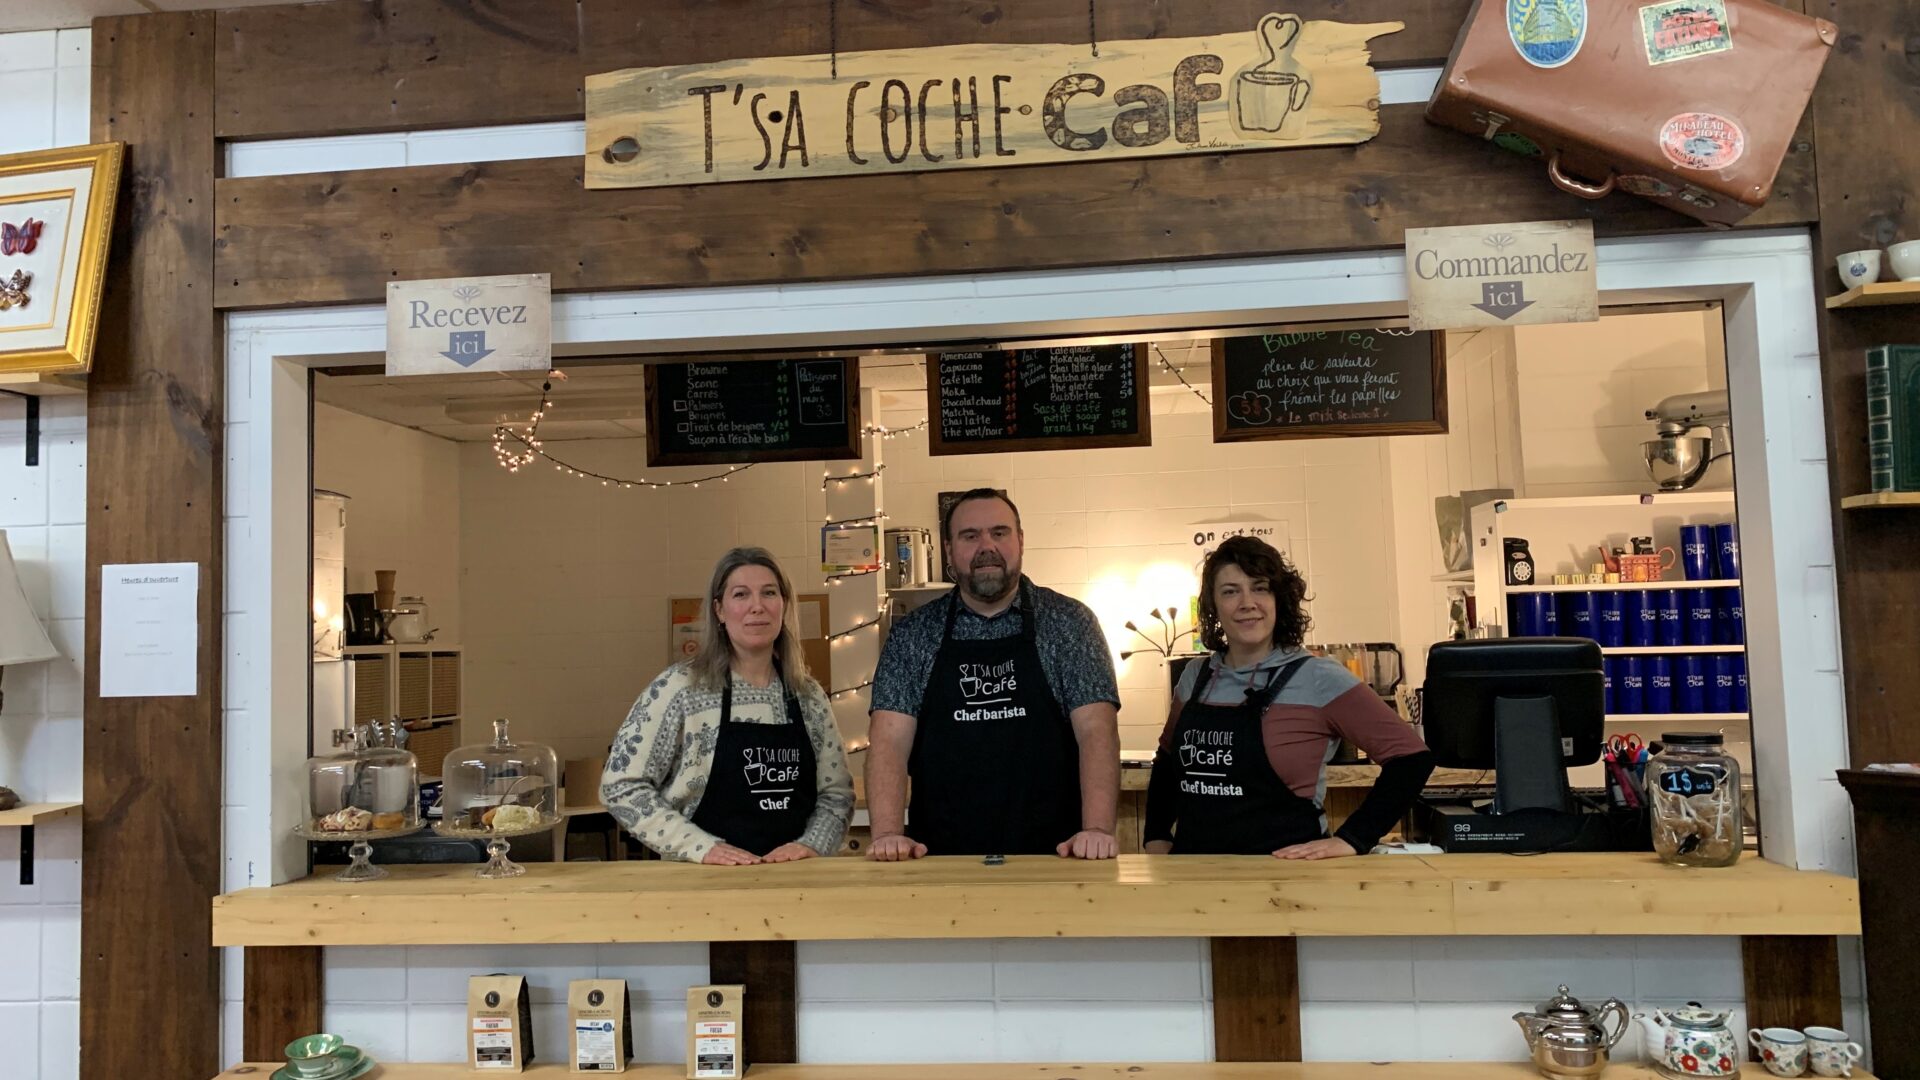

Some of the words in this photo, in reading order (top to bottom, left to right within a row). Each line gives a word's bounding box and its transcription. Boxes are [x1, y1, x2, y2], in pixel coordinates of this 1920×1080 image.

[846, 74, 1016, 165] COCHE
[1670, 120, 1724, 133] MIRABEAU
[1696, 129, 1733, 140] HOTEL
[1415, 242, 1589, 280] Commandez
[1489, 284, 1518, 307] ici
[408, 299, 527, 329] Recevez
[455, 333, 479, 355] ici
[687, 363, 728, 377] Brownie
[1261, 358, 1294, 376] plein
[1300, 357, 1319, 371] de
[1324, 352, 1379, 369] saveurs
[687, 378, 719, 390] Scone
[940, 374, 960, 385] Café
[962, 375, 983, 384] latte
[1257, 378, 1273, 390] au
[1277, 372, 1310, 392] choix
[1314, 376, 1331, 390] qui
[1335, 374, 1359, 384] vous
[1362, 371, 1399, 390] feront
[687, 389, 719, 399] Carrés
[809, 384, 824, 393] du
[941, 387, 966, 396] Moka
[1050, 391, 1084, 401] Bubble
[941, 397, 975, 408] Chocolat
[976, 396, 1002, 406] chaud
[1352, 388, 1401, 407] papilles
[1033, 403, 1055, 415] Sacs
[1060, 402, 1072, 413] de
[1076, 401, 1101, 413] café
[688, 410, 726, 423] Beignes
[943, 417, 964, 427] Chai
[965, 416, 991, 426] latte
[688, 422, 716, 433] Trous
[717, 422, 729, 432] de
[943, 427, 963, 438] thé
[965, 426, 1003, 438] vert/noir
[688, 434, 719, 447] Suçon
[720, 433, 727, 444] à
[764, 432, 779, 443] bio
[1193, 531, 1216, 546] On
[1250, 527, 1274, 537] tous
[992, 659, 1015, 678] COCHE
[982, 675, 1017, 695] Café
[953, 709, 982, 721] Chef
[983, 706, 1026, 720] barista
[1208, 730, 1234, 746] COCHE
[777, 748, 800, 763] COCHE
[1196, 749, 1233, 766] Café
[766, 765, 800, 782] Café
[1180, 780, 1199, 794] Chef
[1200, 781, 1243, 796] barista
[1667, 770, 1692, 793] 1$
[759, 796, 791, 810] Chef
